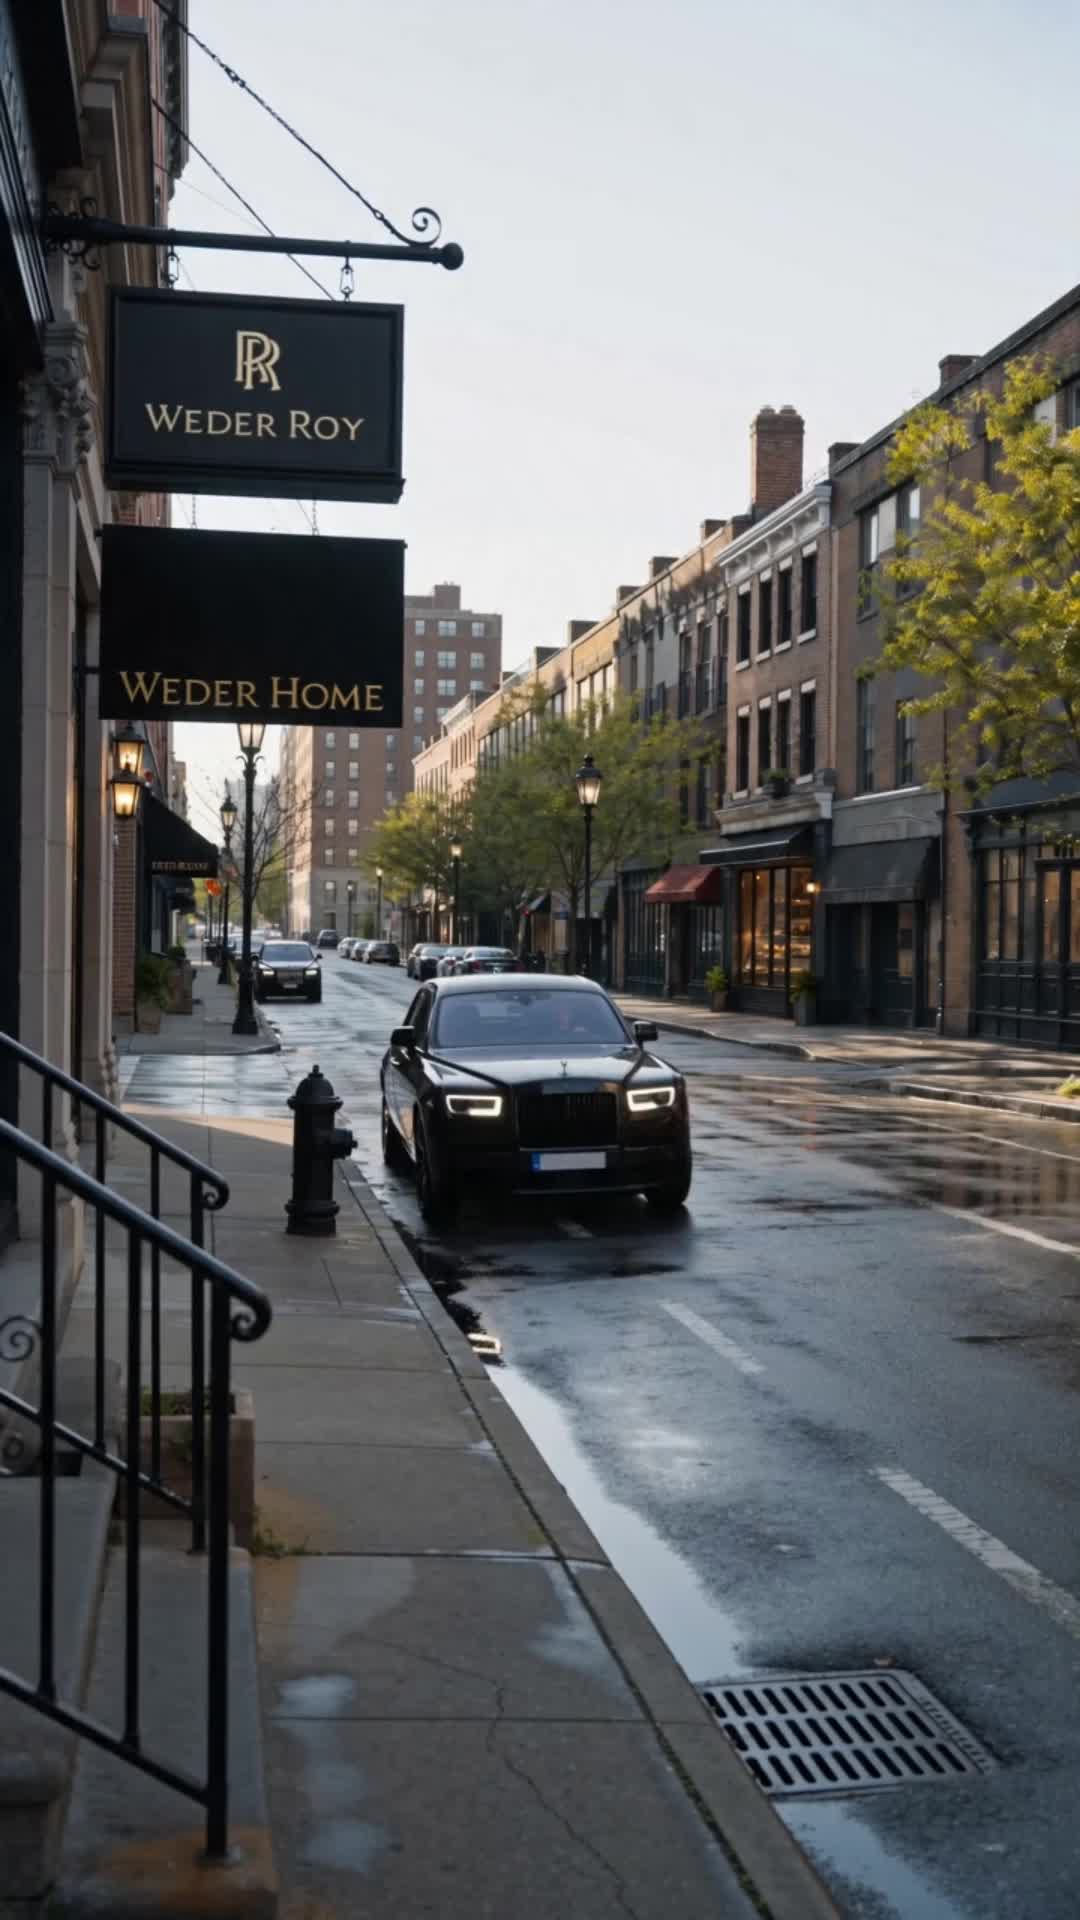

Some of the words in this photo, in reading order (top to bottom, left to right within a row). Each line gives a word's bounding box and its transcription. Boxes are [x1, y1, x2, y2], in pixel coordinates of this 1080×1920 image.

[145, 403, 277, 438] WEDER
[289, 409, 365, 441] ROY
[119, 671, 260, 708] WEDER
[271, 676, 384, 712] HOME
